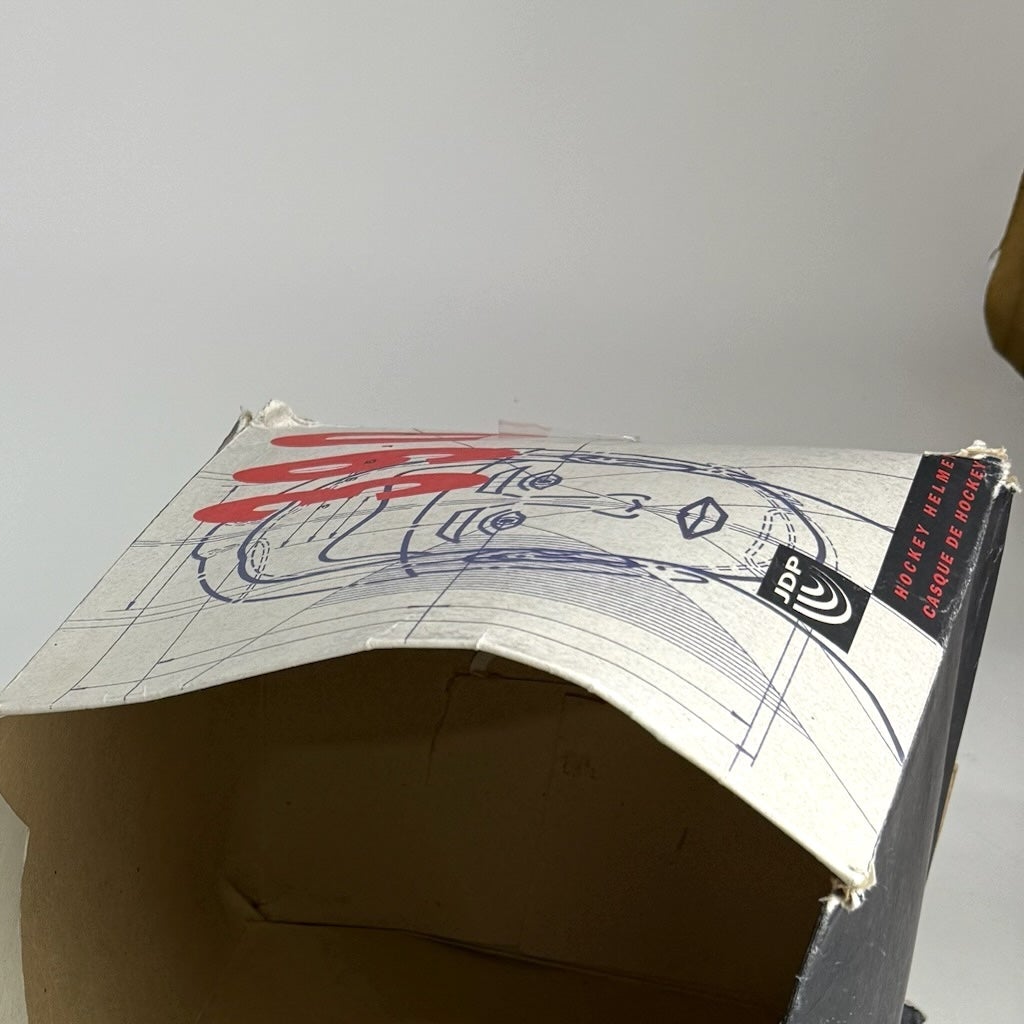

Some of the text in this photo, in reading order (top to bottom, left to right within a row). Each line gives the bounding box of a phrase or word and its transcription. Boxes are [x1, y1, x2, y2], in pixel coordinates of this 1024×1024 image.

[774, 556, 802, 605] JDP
[894, 456, 957, 601] HOCKEY HELME
[922, 460, 986, 619] CASQUE DE HOCKEY
